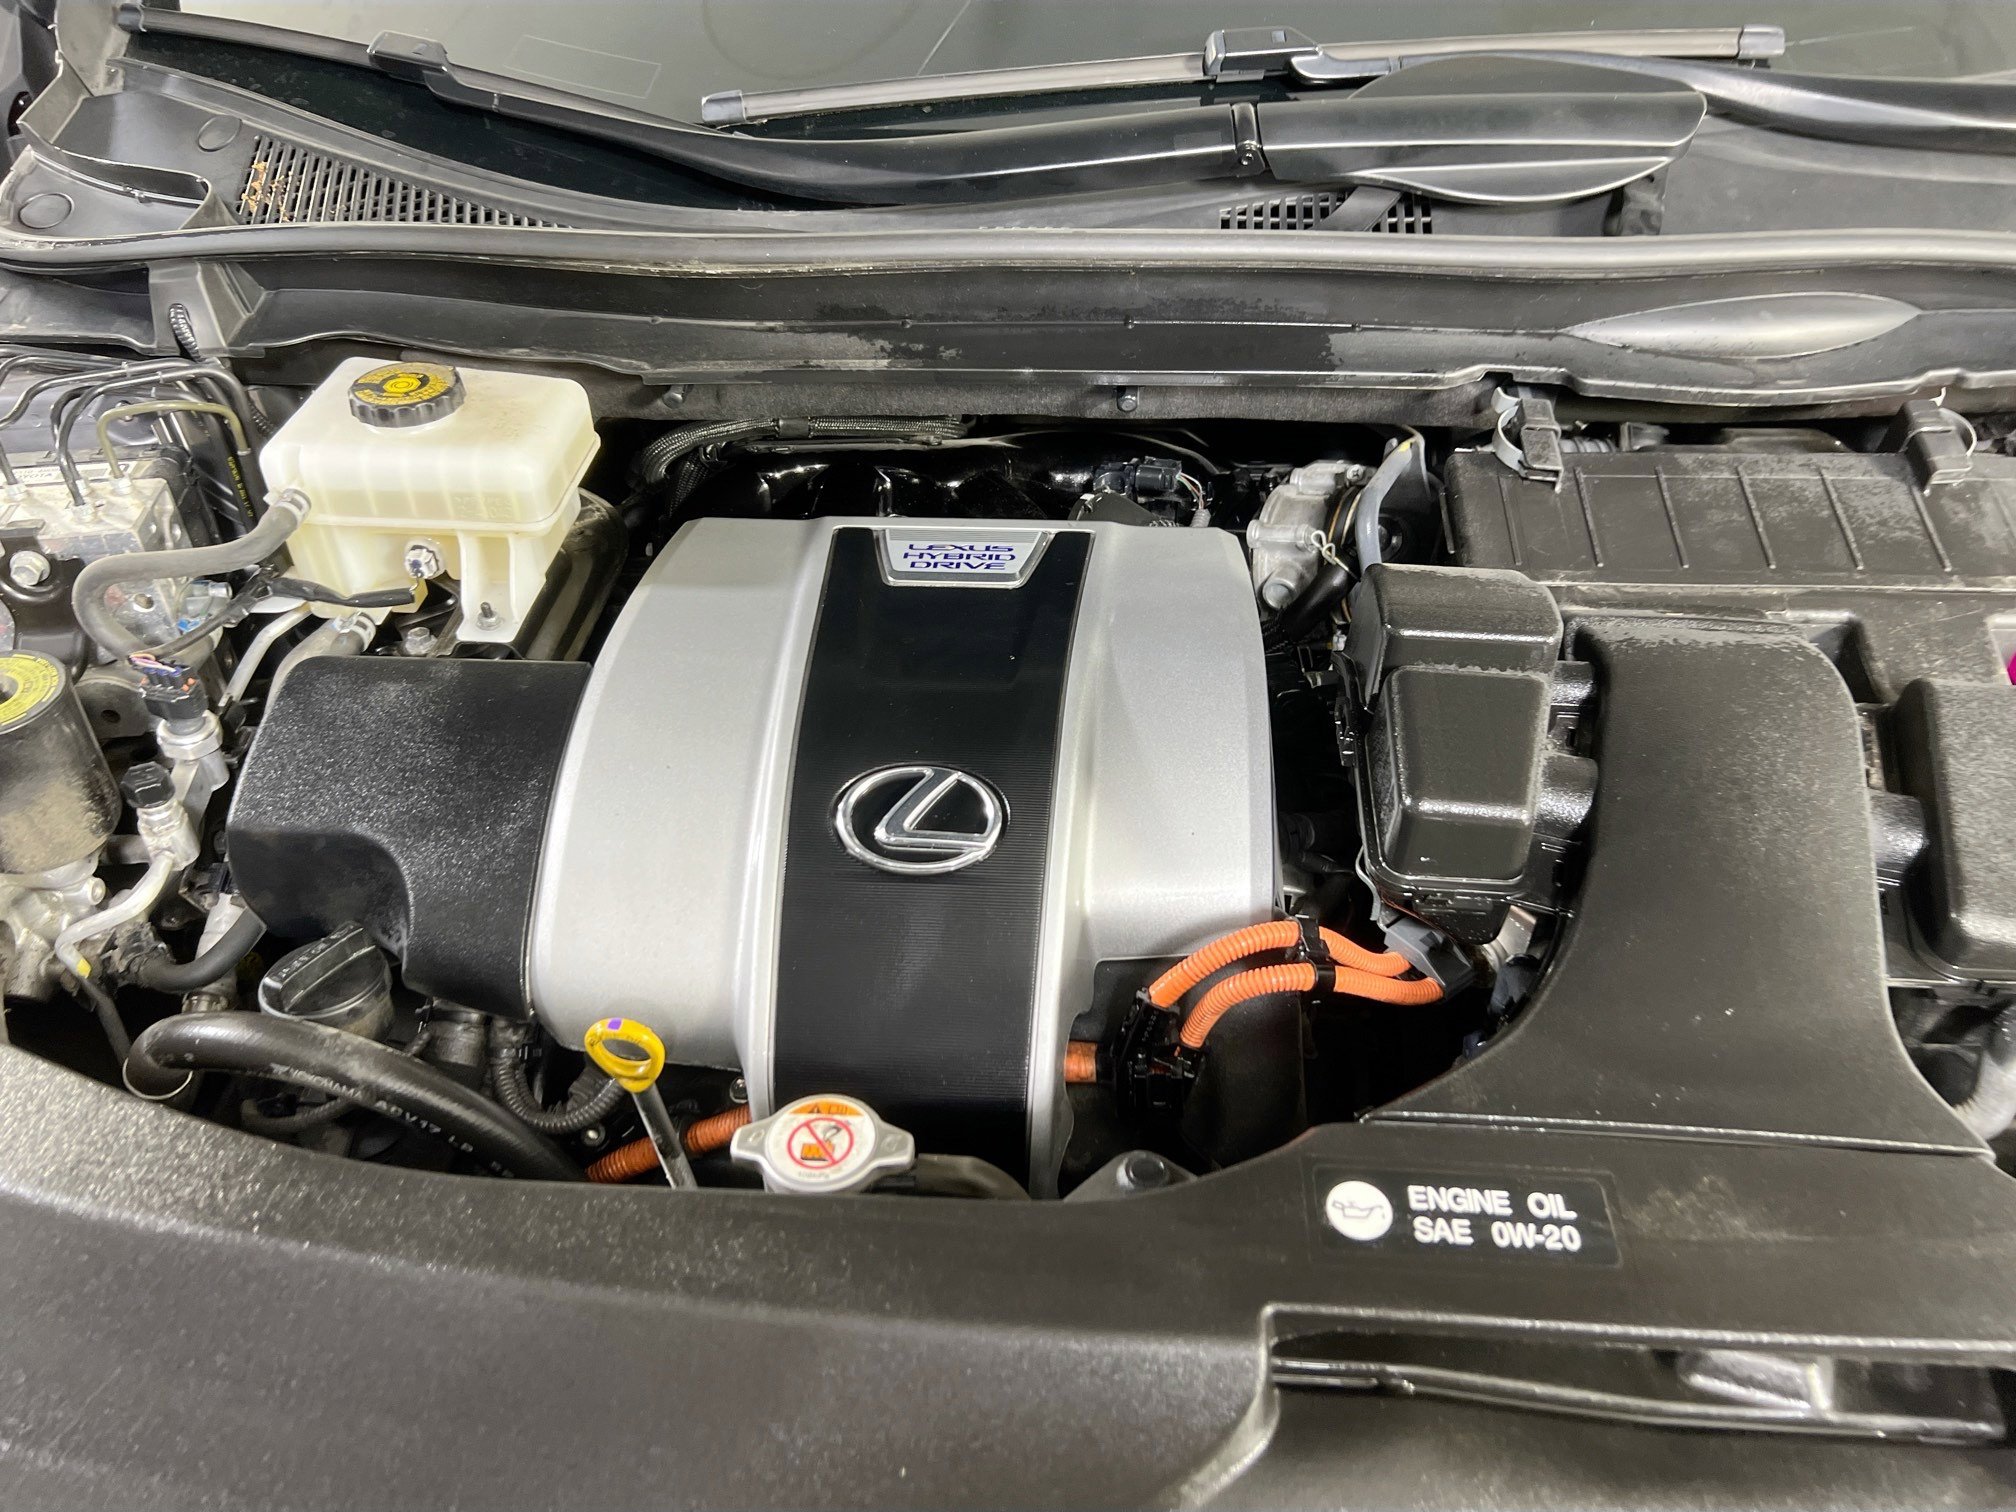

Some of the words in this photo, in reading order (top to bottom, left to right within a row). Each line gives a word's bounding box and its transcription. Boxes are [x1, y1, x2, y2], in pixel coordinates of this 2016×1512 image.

[908, 543, 1014, 553] LEXUS
[903, 552, 1016, 561] HYBRID
[910, 561, 1006, 569] DRIVE
[1406, 1184, 1513, 1216] ENGINE
[1526, 1191, 1578, 1220] OIL
[1412, 1216, 1475, 1245] SAE
[1491, 1220, 1582, 1252] 0W-20
